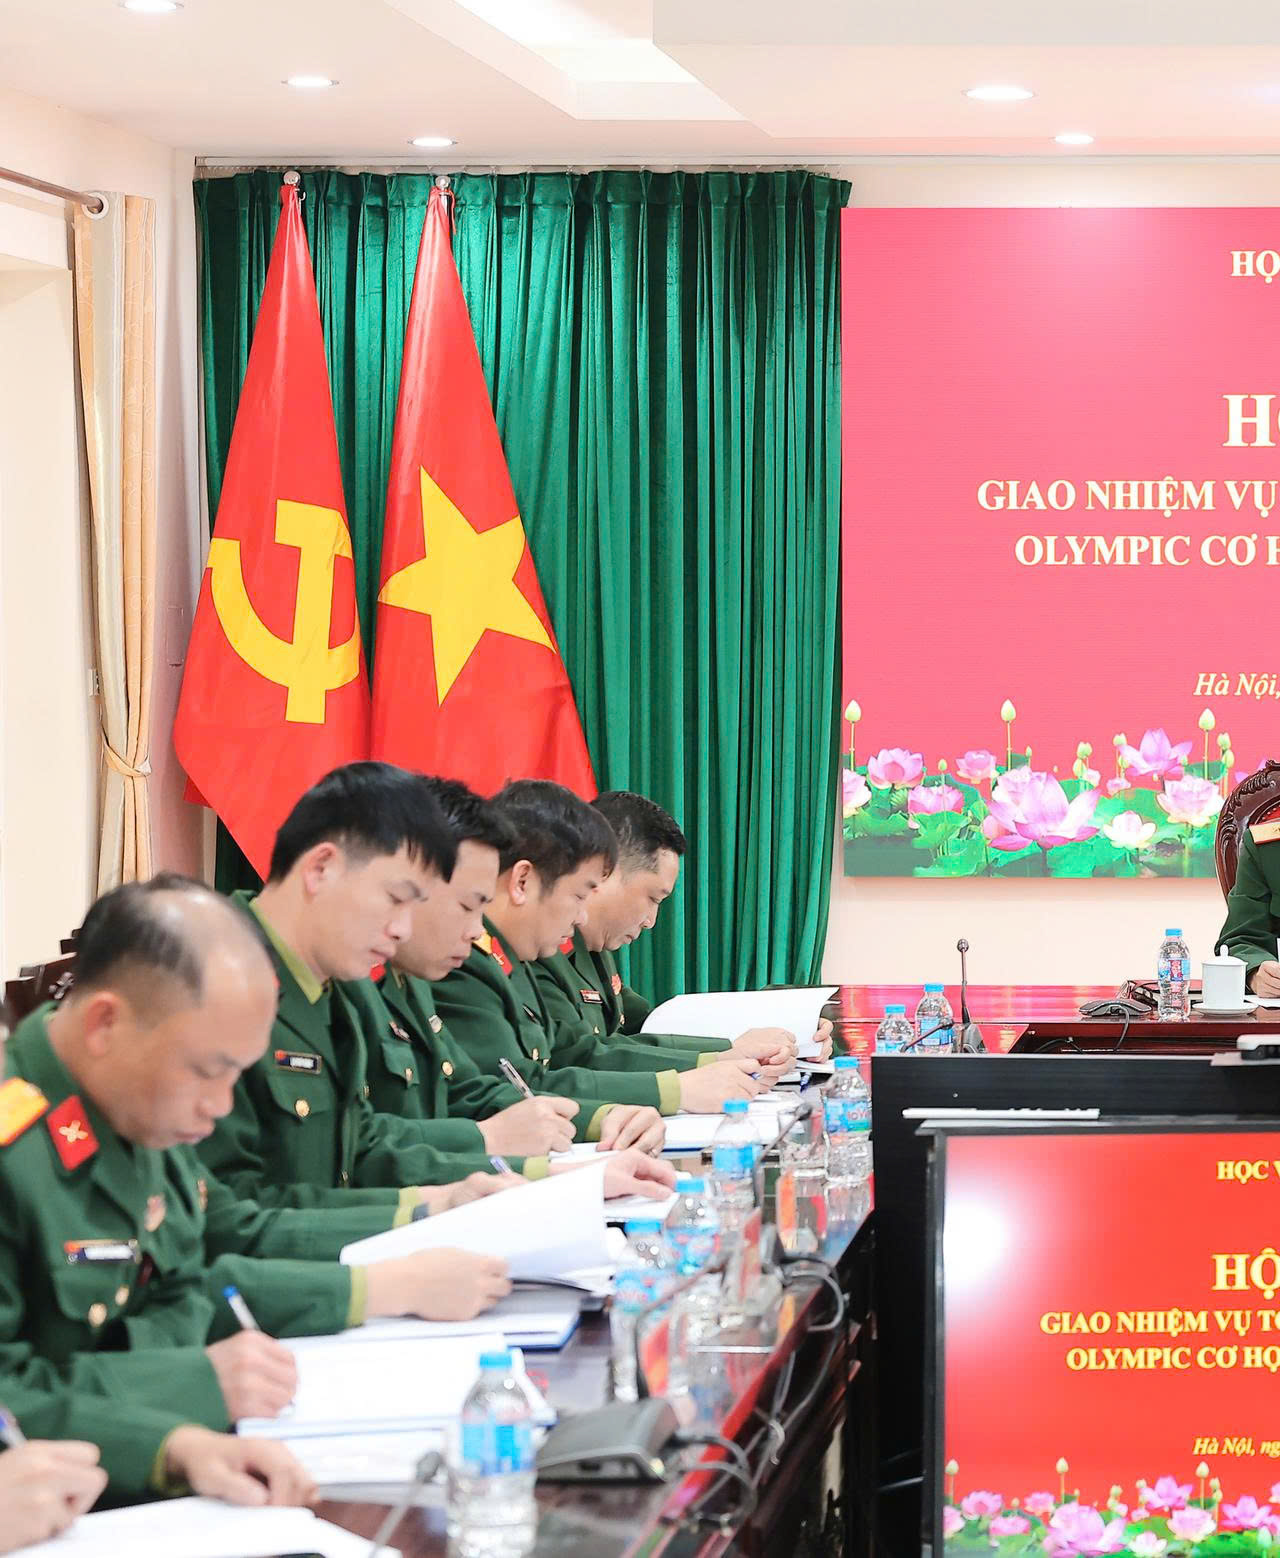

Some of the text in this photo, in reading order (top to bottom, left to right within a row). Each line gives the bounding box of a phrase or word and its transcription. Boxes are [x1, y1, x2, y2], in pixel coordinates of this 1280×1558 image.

[977, 479, 1076, 511] GIAO
[1085, 475, 1216, 518] NHIỆM
[1223, 480, 1279, 518] VỤ
[1015, 535, 1191, 566] OLYMPIC
[1200, 533, 1258, 566] CƠ
[1193, 672, 1229, 696] Hà
[1234, 673, 1280, 700] Nội,
[1216, 1160, 1270, 1185] HỌC
[1039, 1311, 1112, 1335] GIAO
[1116, 1307, 1209, 1338] NHIỆM
[1213, 1309, 1252, 1337] VỤ
[1066, 1346, 1192, 1371] OLYMPIC
[1196, 1345, 1239, 1369] CƠ
[1192, 1437, 1219, 1456] Hà
[1221, 1437, 1256, 1458] Nội,
